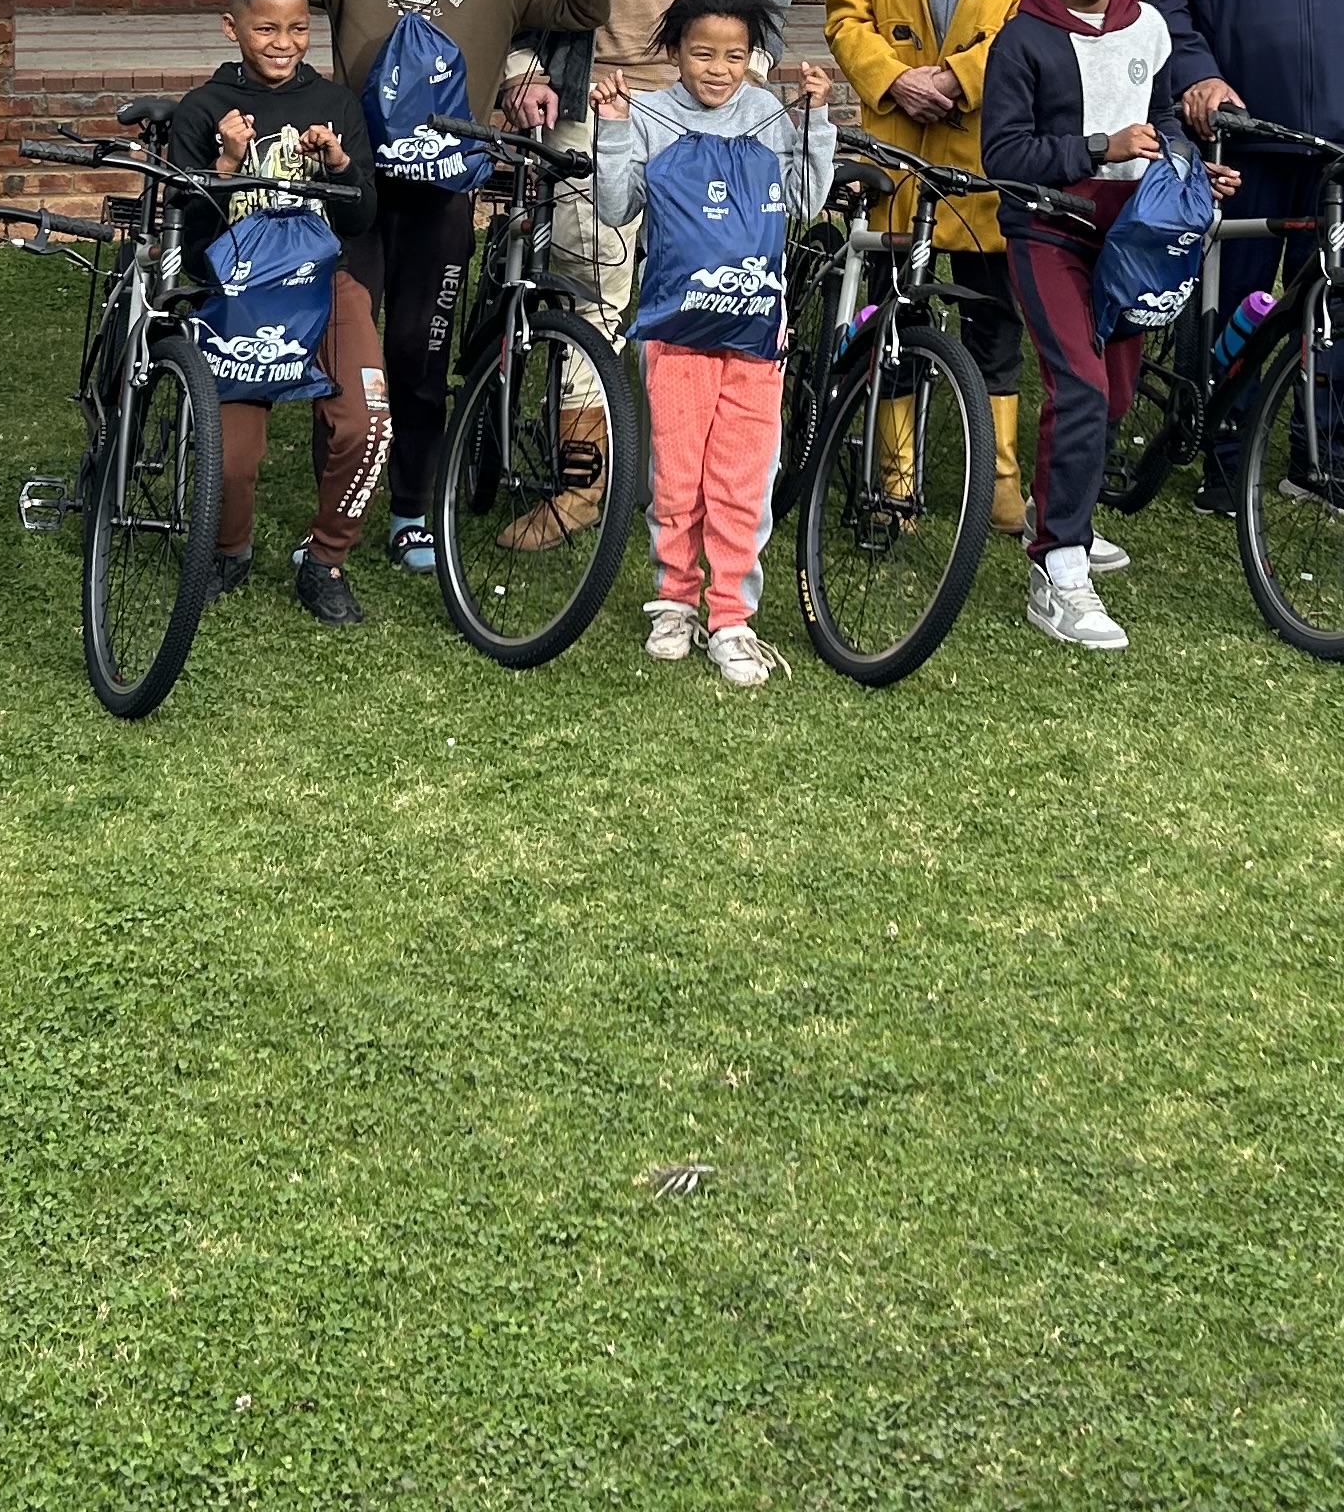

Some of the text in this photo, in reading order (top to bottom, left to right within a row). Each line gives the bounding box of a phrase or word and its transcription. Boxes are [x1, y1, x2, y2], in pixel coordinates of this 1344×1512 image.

[393, 161, 436, 181] CYCLE
[436, 151, 468, 180] TOUR
[428, 264, 462, 351] NEW GEN
[702, 292, 748, 315] CYCLE
[219, 359, 304, 383] CYCLE TOUR
[799, 568, 816, 622] KENDA
